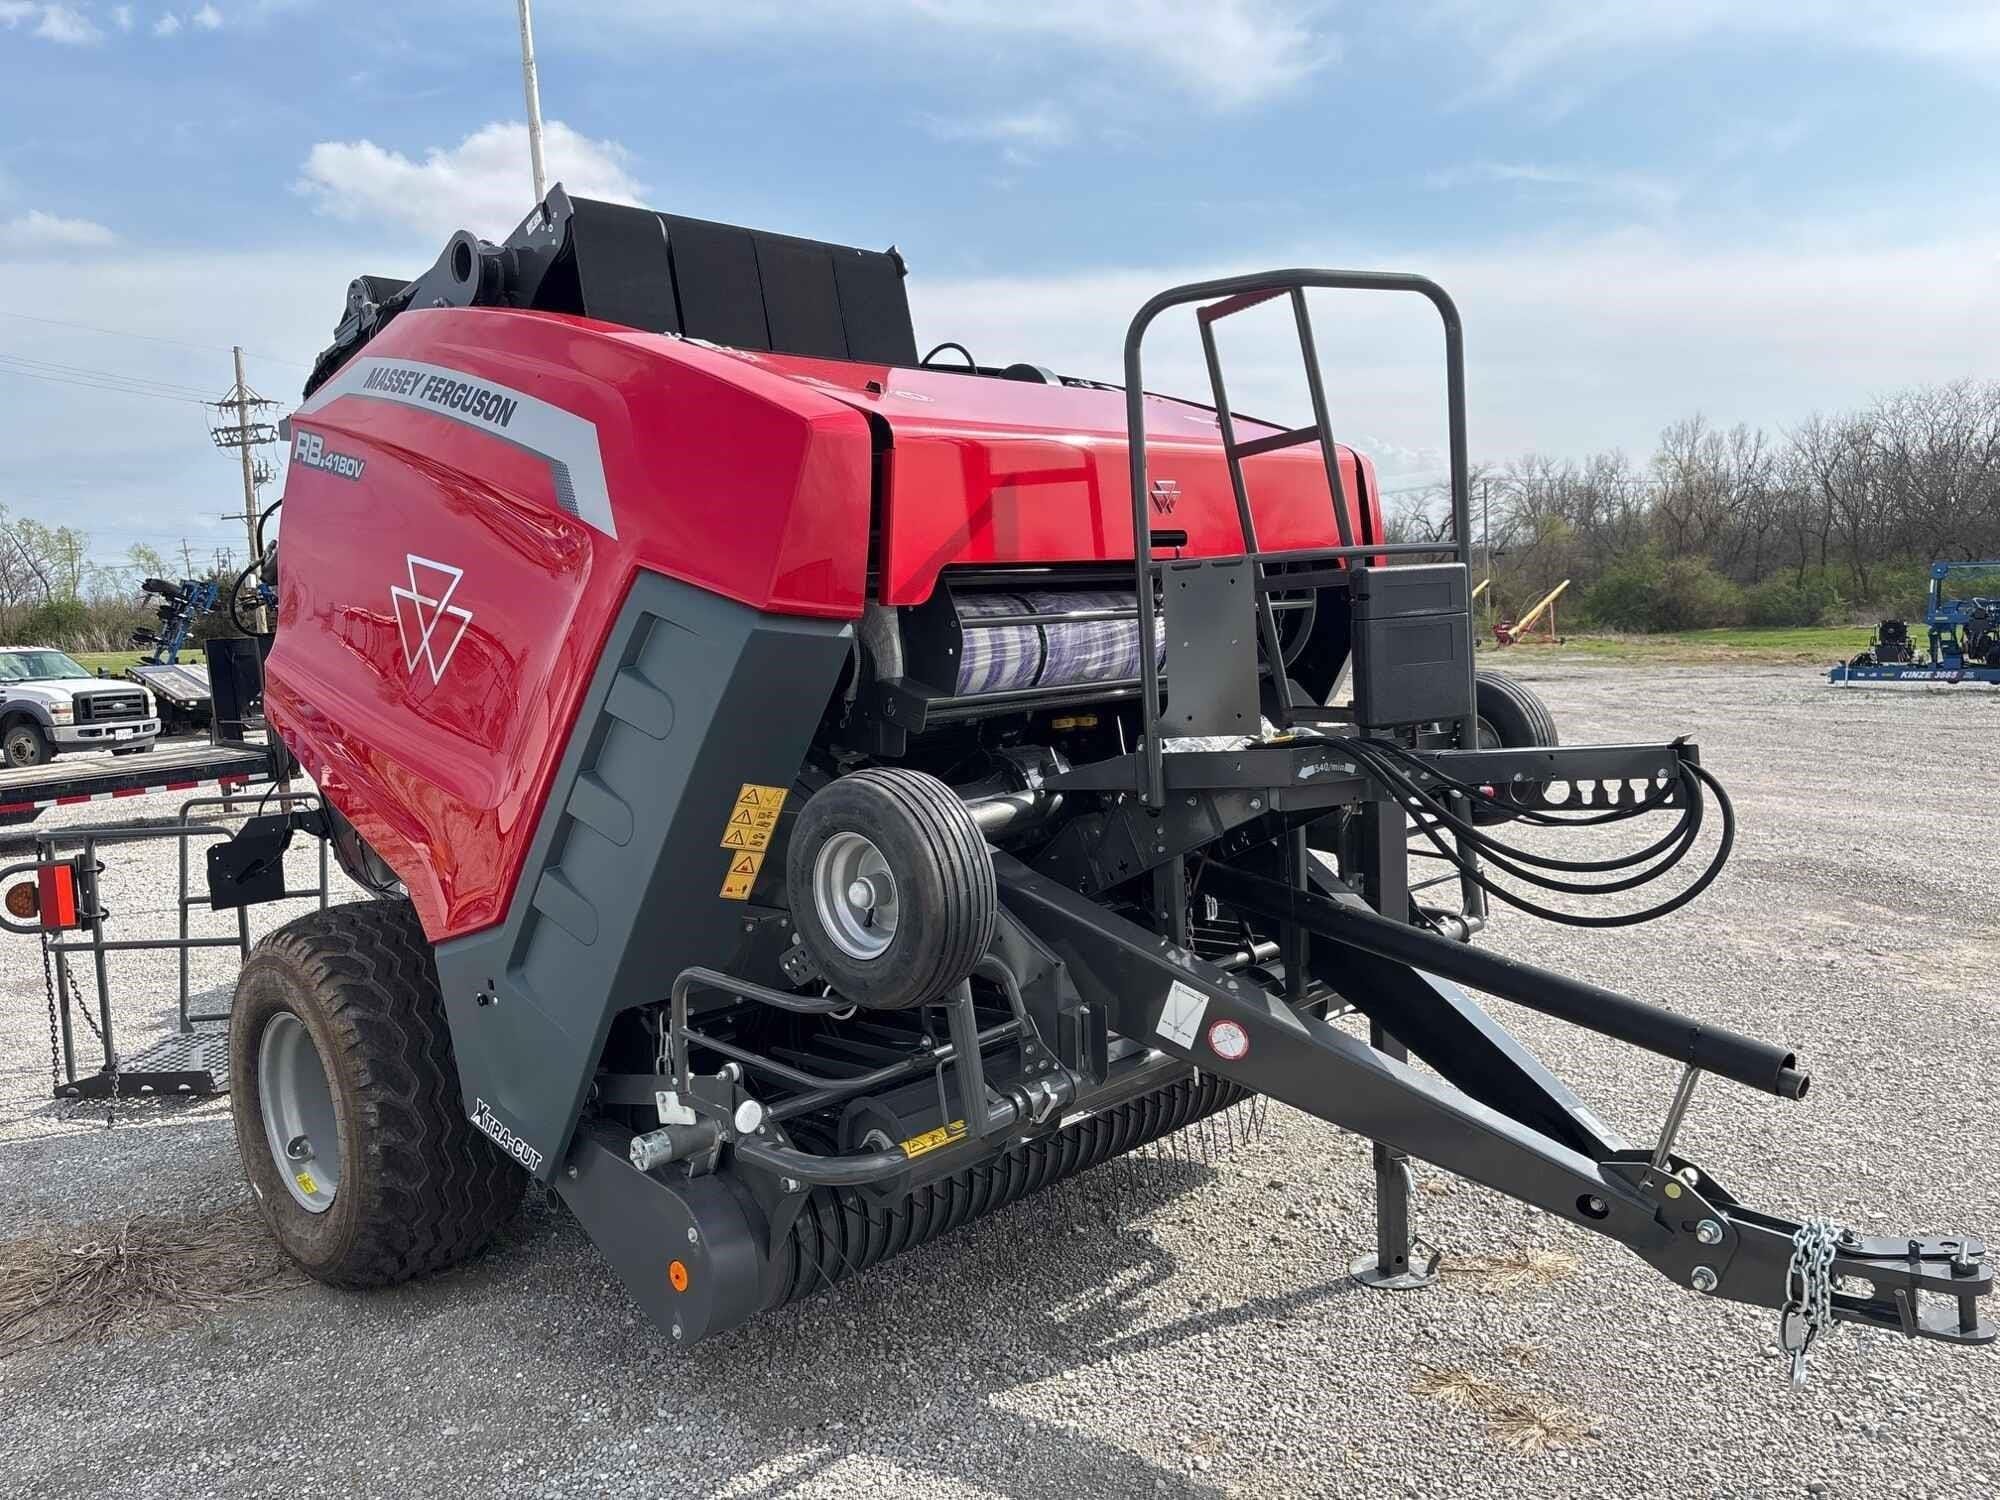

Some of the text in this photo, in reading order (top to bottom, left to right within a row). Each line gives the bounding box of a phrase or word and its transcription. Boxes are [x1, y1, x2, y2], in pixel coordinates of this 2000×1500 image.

[363, 367, 518, 428] MASSEY FERGUSON
[1900, 671, 1933, 679] KINZE
[470, 1097, 543, 1172] XTRA-CUT
